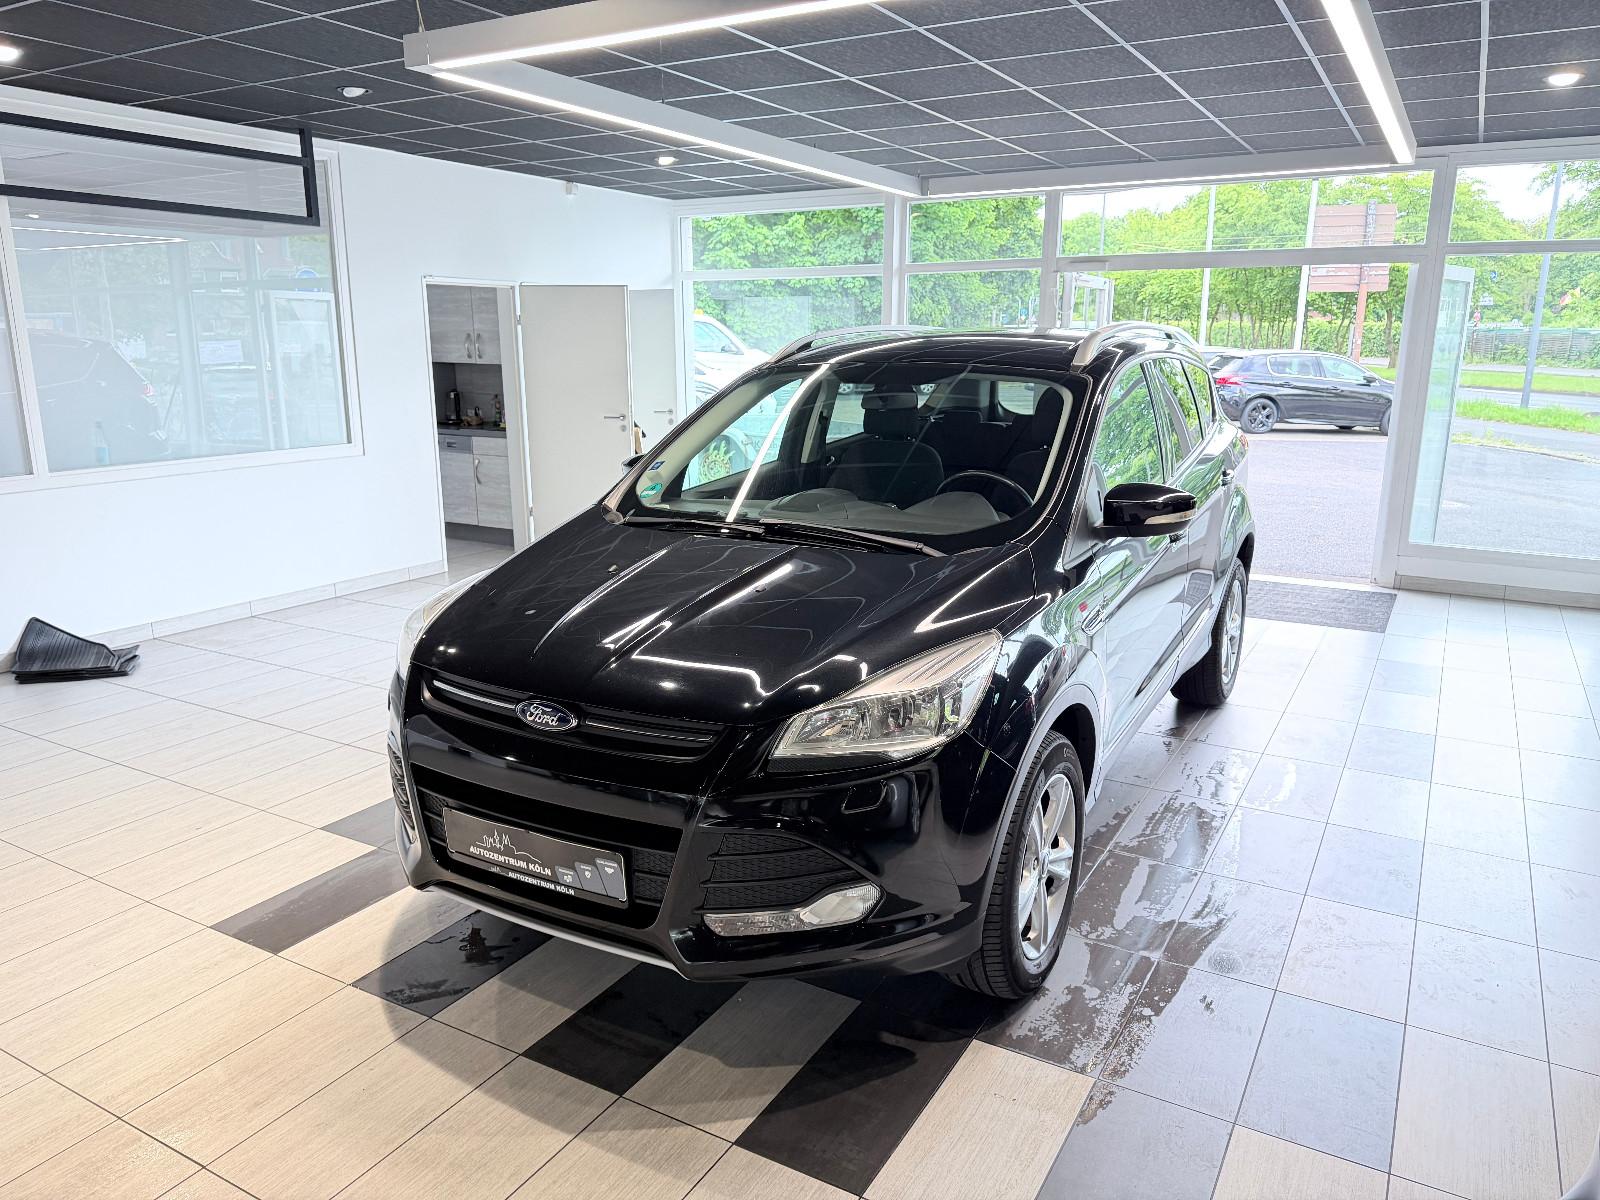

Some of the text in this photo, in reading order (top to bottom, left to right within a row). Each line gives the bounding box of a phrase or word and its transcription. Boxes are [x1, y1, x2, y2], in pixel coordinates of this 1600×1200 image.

[526, 703, 559, 726] Ford
[469, 845, 552, 877] AUTOZENTRUM KÖLN
[508, 871, 555, 890] AUTOZENTRUM
[555, 884, 575, 896] KÖLN
